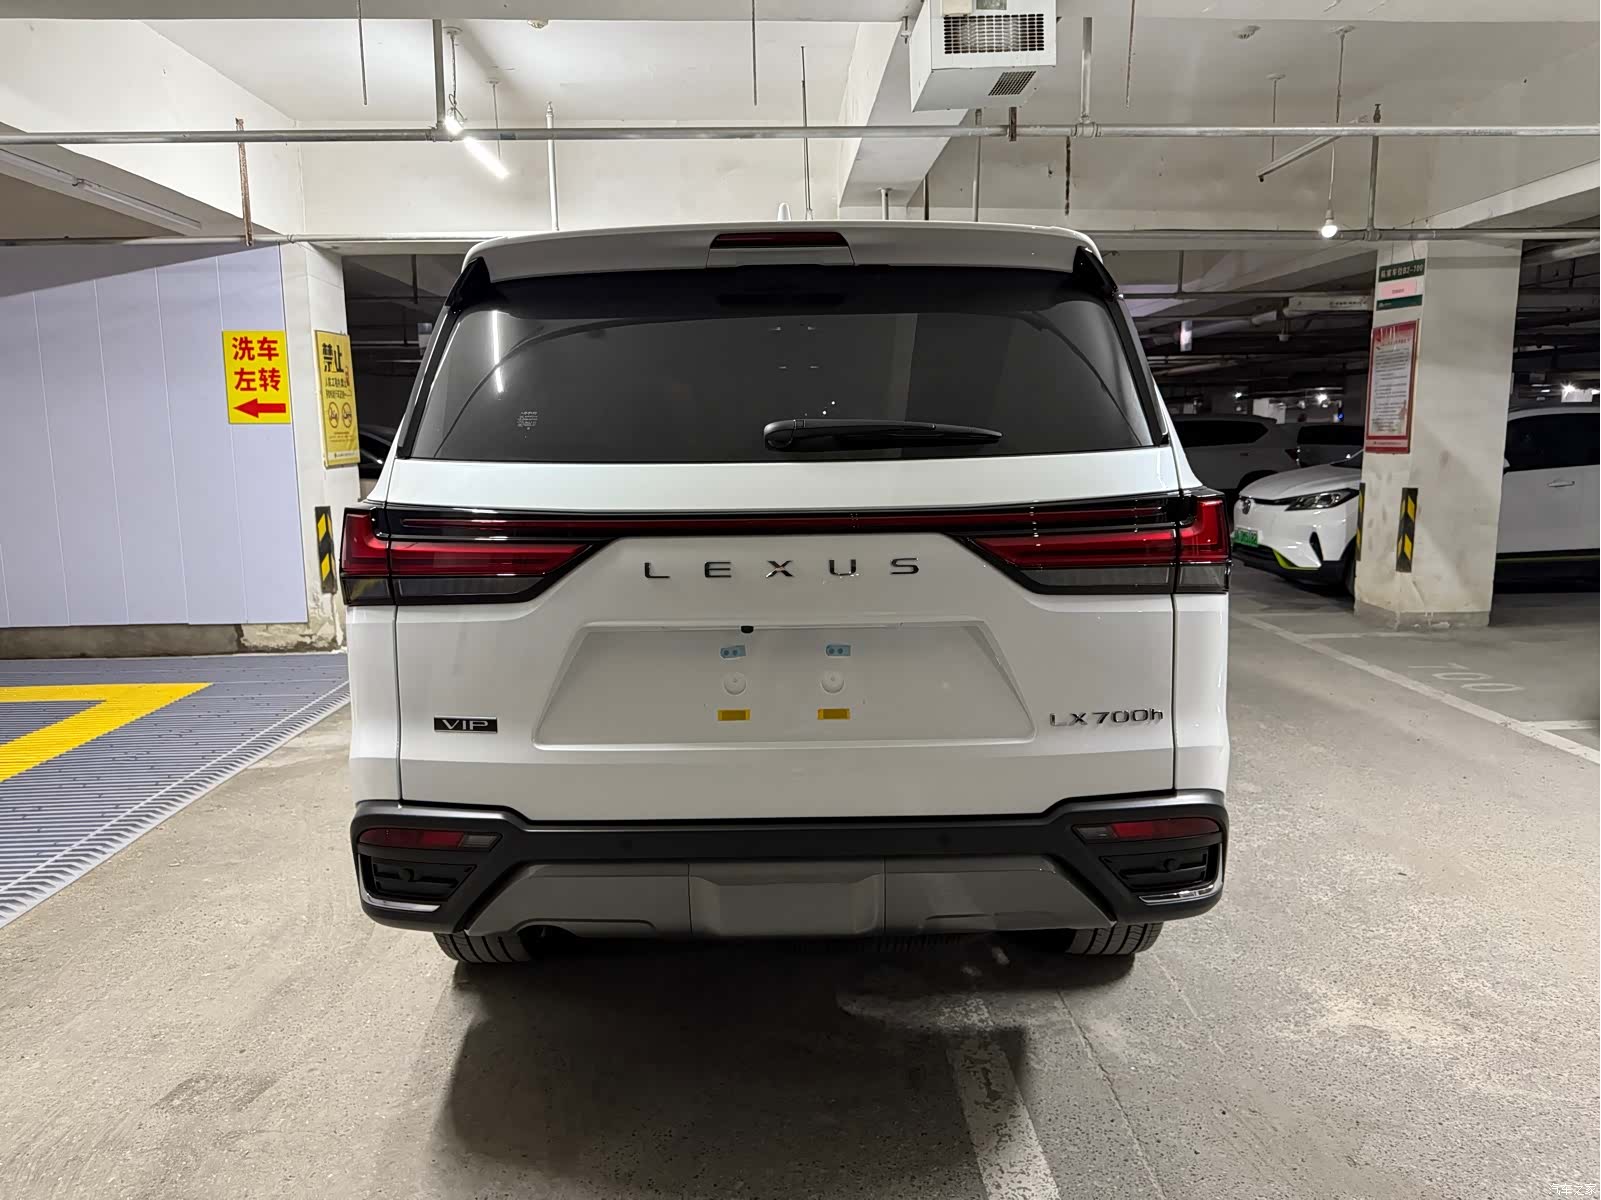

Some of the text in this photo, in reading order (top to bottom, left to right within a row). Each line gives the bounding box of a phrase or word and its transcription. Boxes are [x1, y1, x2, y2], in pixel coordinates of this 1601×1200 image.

[232, 336, 279, 361] 洗车
[322, 343, 344, 373] 禁止
[234, 367, 281, 392] 左转
[644, 557, 920, 579] LEXUS
[1407, 662, 1525, 692] 700
[442, 719, 489, 730] VIP
